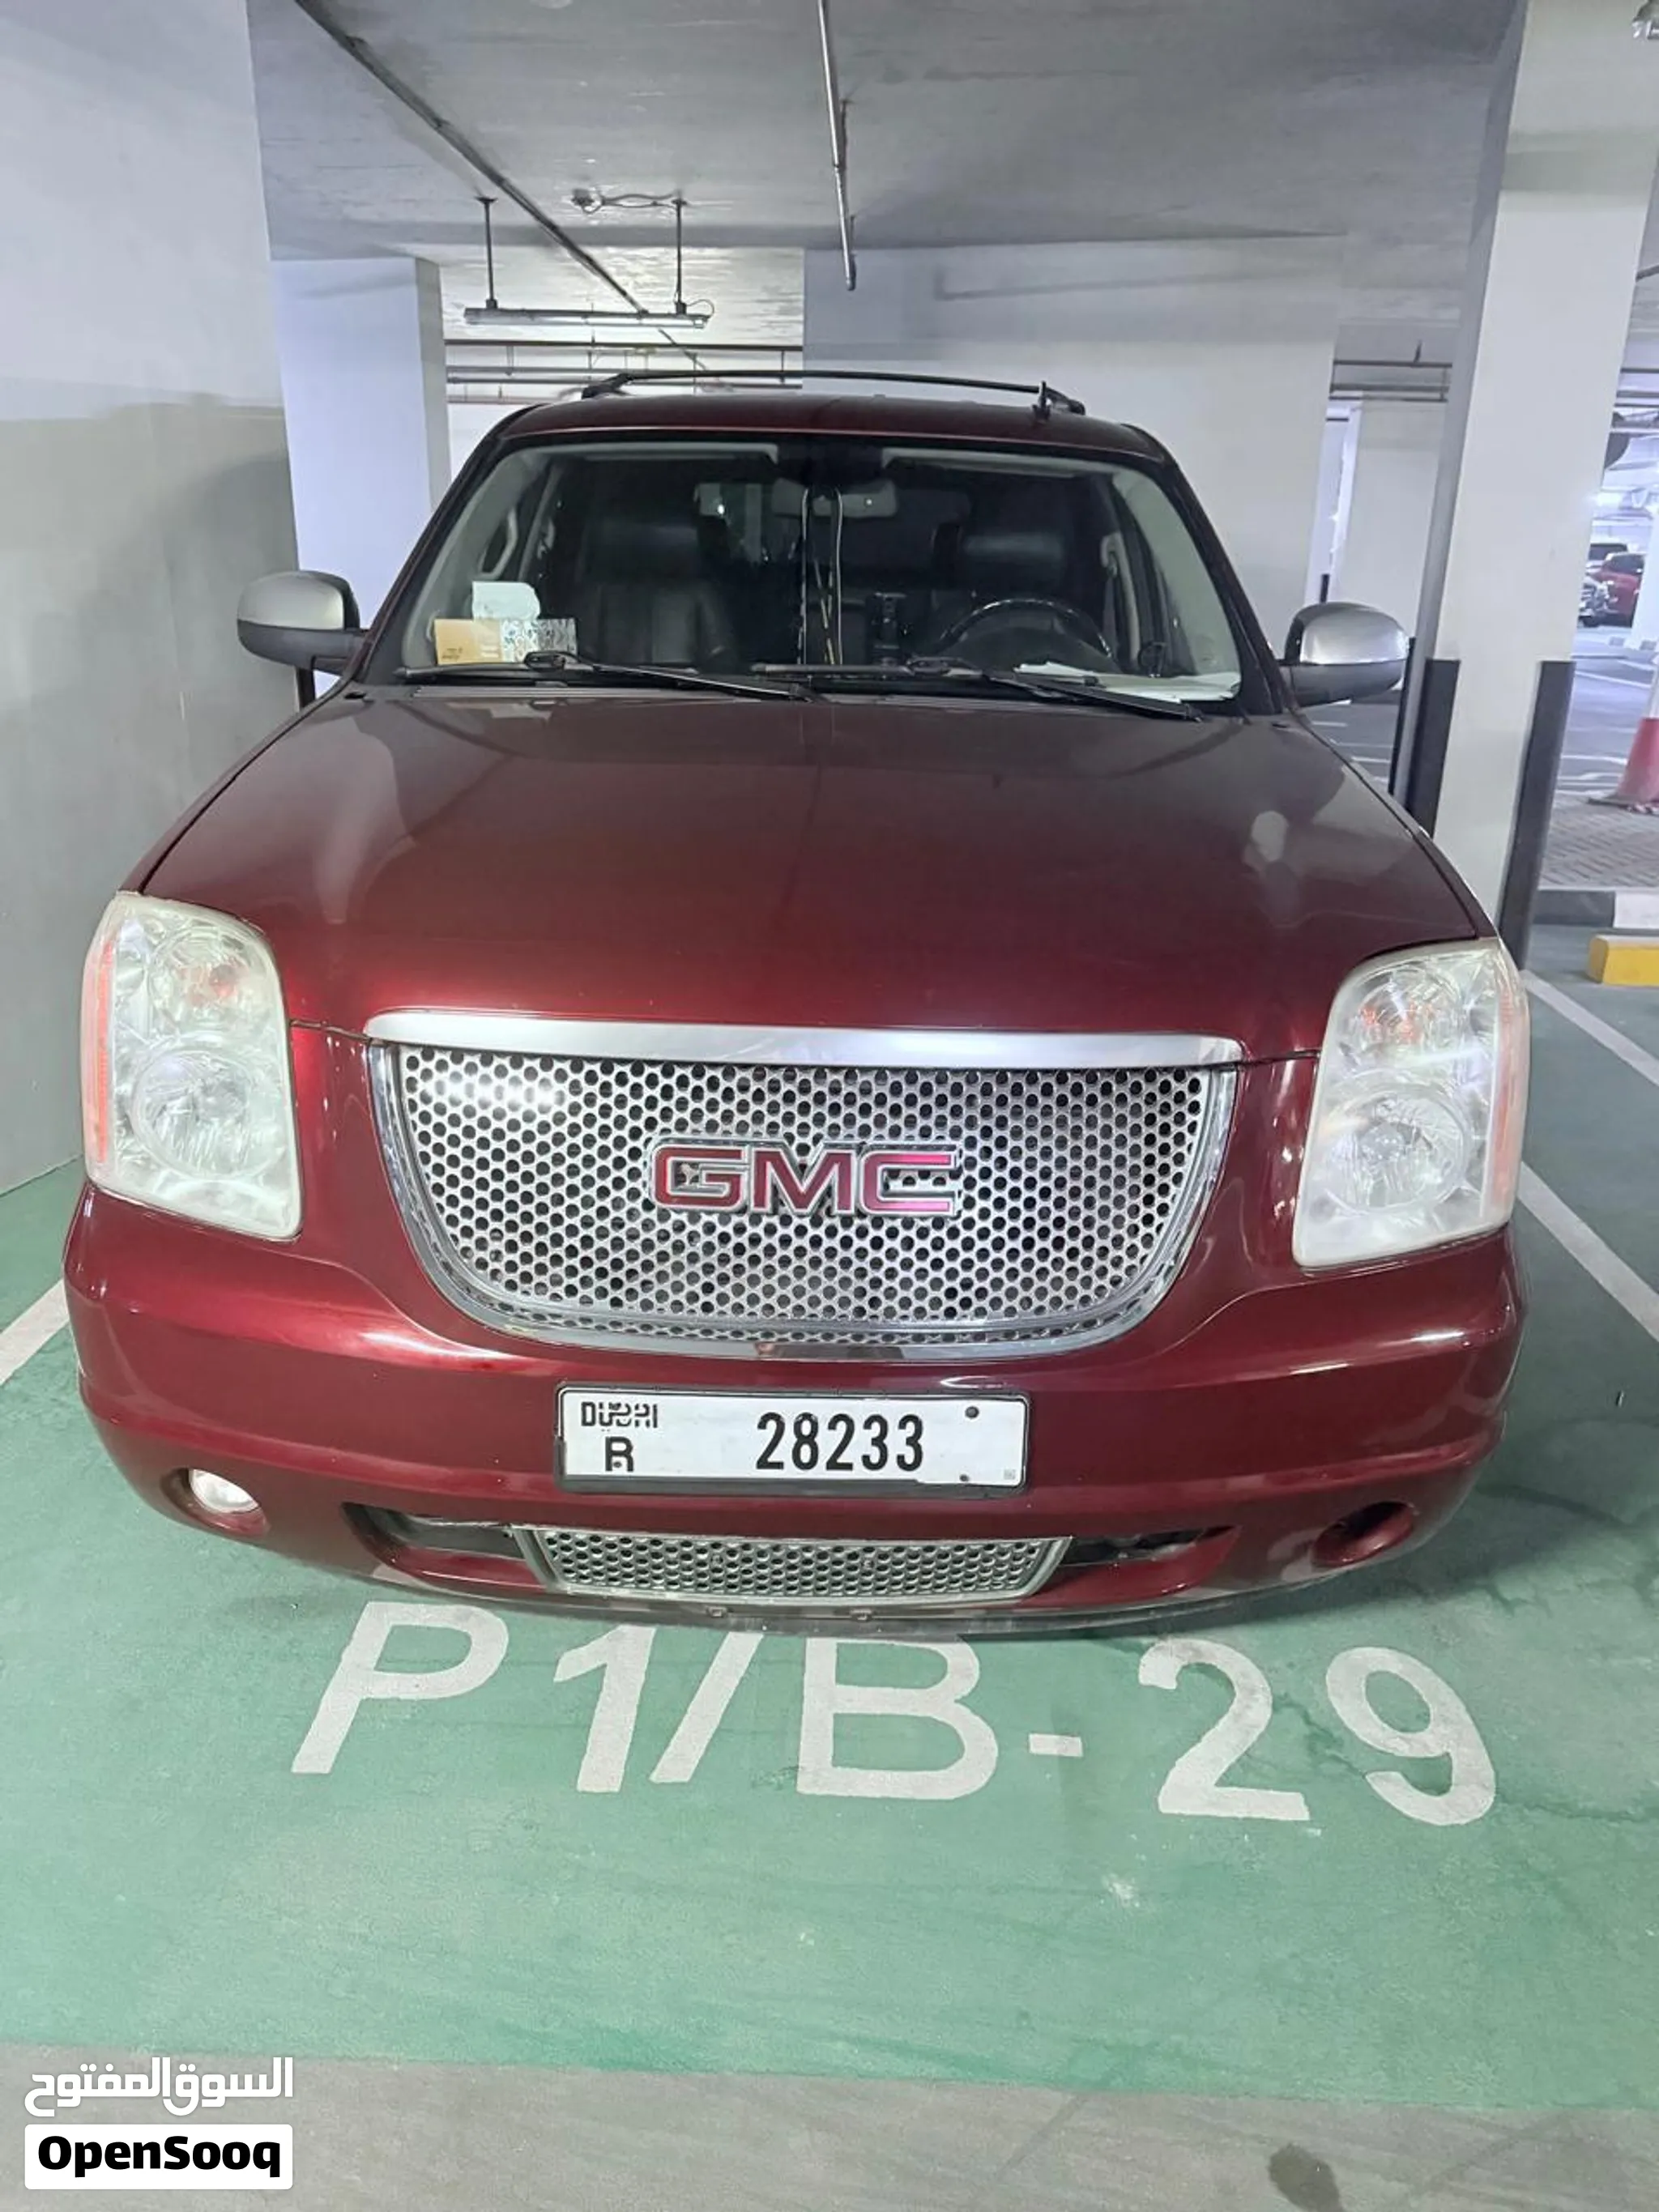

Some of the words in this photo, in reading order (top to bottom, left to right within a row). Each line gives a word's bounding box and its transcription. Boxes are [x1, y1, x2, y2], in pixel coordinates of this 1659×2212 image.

[650, 1137, 962, 1217] GMC
[605, 1436, 633, 1472] R
[756, 1412, 924, 1472] 28233
